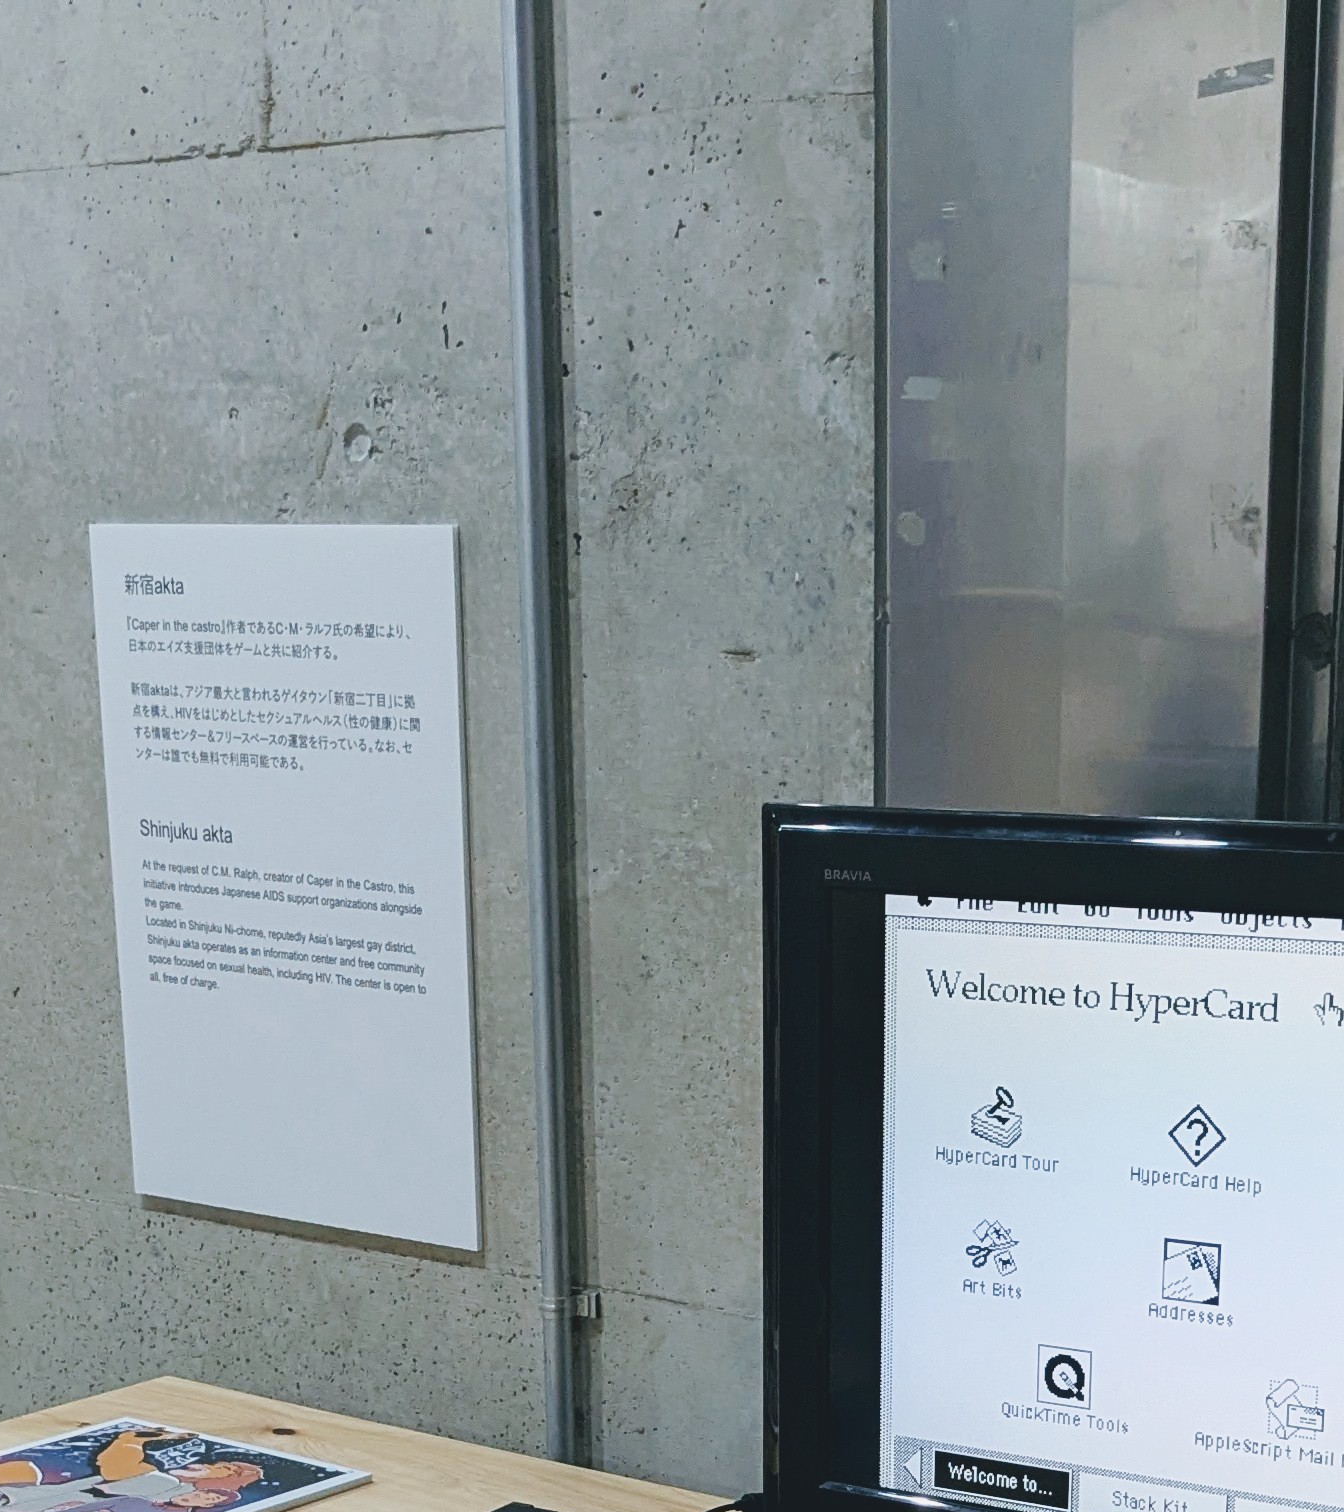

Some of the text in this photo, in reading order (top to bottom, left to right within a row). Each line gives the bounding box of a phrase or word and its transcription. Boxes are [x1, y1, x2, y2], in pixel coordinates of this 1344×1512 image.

[124, 573, 185, 596] 新宿akta
[162, 619, 171, 632] in
[173, 619, 189, 633] the
[128, 638, 338, 661] 日本のエイズ支援団体をゲームと共に紹介する。
[135, 747, 304, 772] ンターは誰でも無料で利用可能である。
[139, 818, 233, 844] Shinjuku akta
[141, 859, 415, 895] At the request of C.M. Ralph, creator of Caper in the Castro, this
[824, 869, 872, 882] BRAVIA
[143, 878, 423, 917] initiative introduces Japanese AIDS support organizations alongside
[144, 897, 184, 912] the game.
[145, 914, 178, 929] Located
[179, 918, 187, 930] in
[187, 919, 223, 935] Shinjuku
[268, 930, 307, 945] reputedly
[308, 932, 334, 946] Asia's
[335, 935, 365, 951] largest
[366, 940, 383, 954] gay
[146, 933, 426, 978] Shinjuku akta operates as an information center and free community
[148, 954, 427, 995] space focused on sexual health, including HIV. The center is open to
[162, 971, 179, 985] free
[180, 974, 189, 986] of
[189, 976, 220, 991] charge.
[925, 968, 1279, 1024] Welcome to HyperCard
[935, 1145, 1060, 1173] HyperCard Tour
[1130, 1166, 1262, 1198] HyperCard Help
[962, 1278, 1022, 1300] Art Bits
[1148, 1302, 1234, 1328] Addresses
[1001, 1401, 1129, 1435] QuickTime Tools
[1194, 1431, 1292, 1462] AppleScript
[1298, 1446, 1335, 1467] Mail
[948, 1461, 1053, 1497] Welcome to...
[1111, 1490, 1157, 1512] Stack
